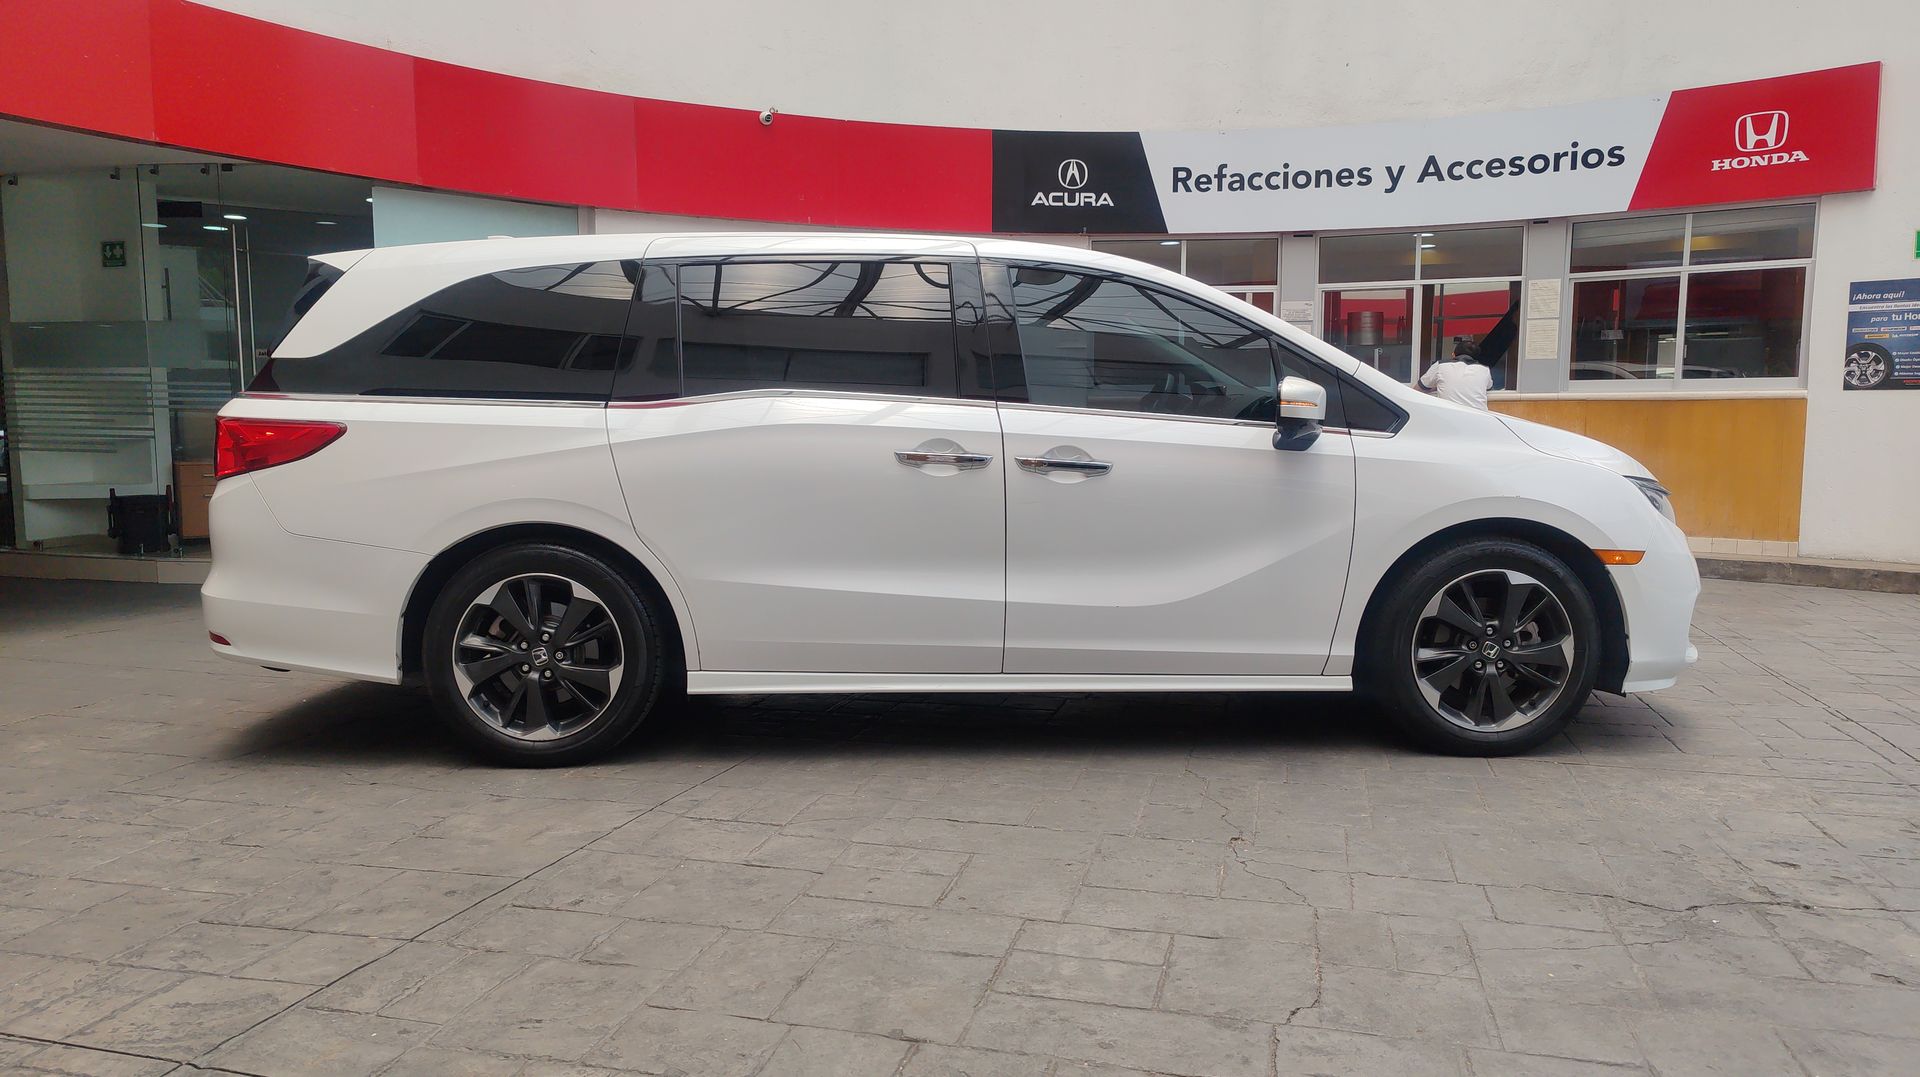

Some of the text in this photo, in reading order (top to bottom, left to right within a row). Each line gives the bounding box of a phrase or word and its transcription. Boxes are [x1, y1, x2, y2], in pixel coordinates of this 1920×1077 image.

[1172, 141, 1625, 193] Refacciones y Accesorios
[1711, 150, 1810, 171] HONDA
[1031, 191, 1114, 207] ACURA
[1853, 290, 1905, 301] ¡Ahora aquí!
